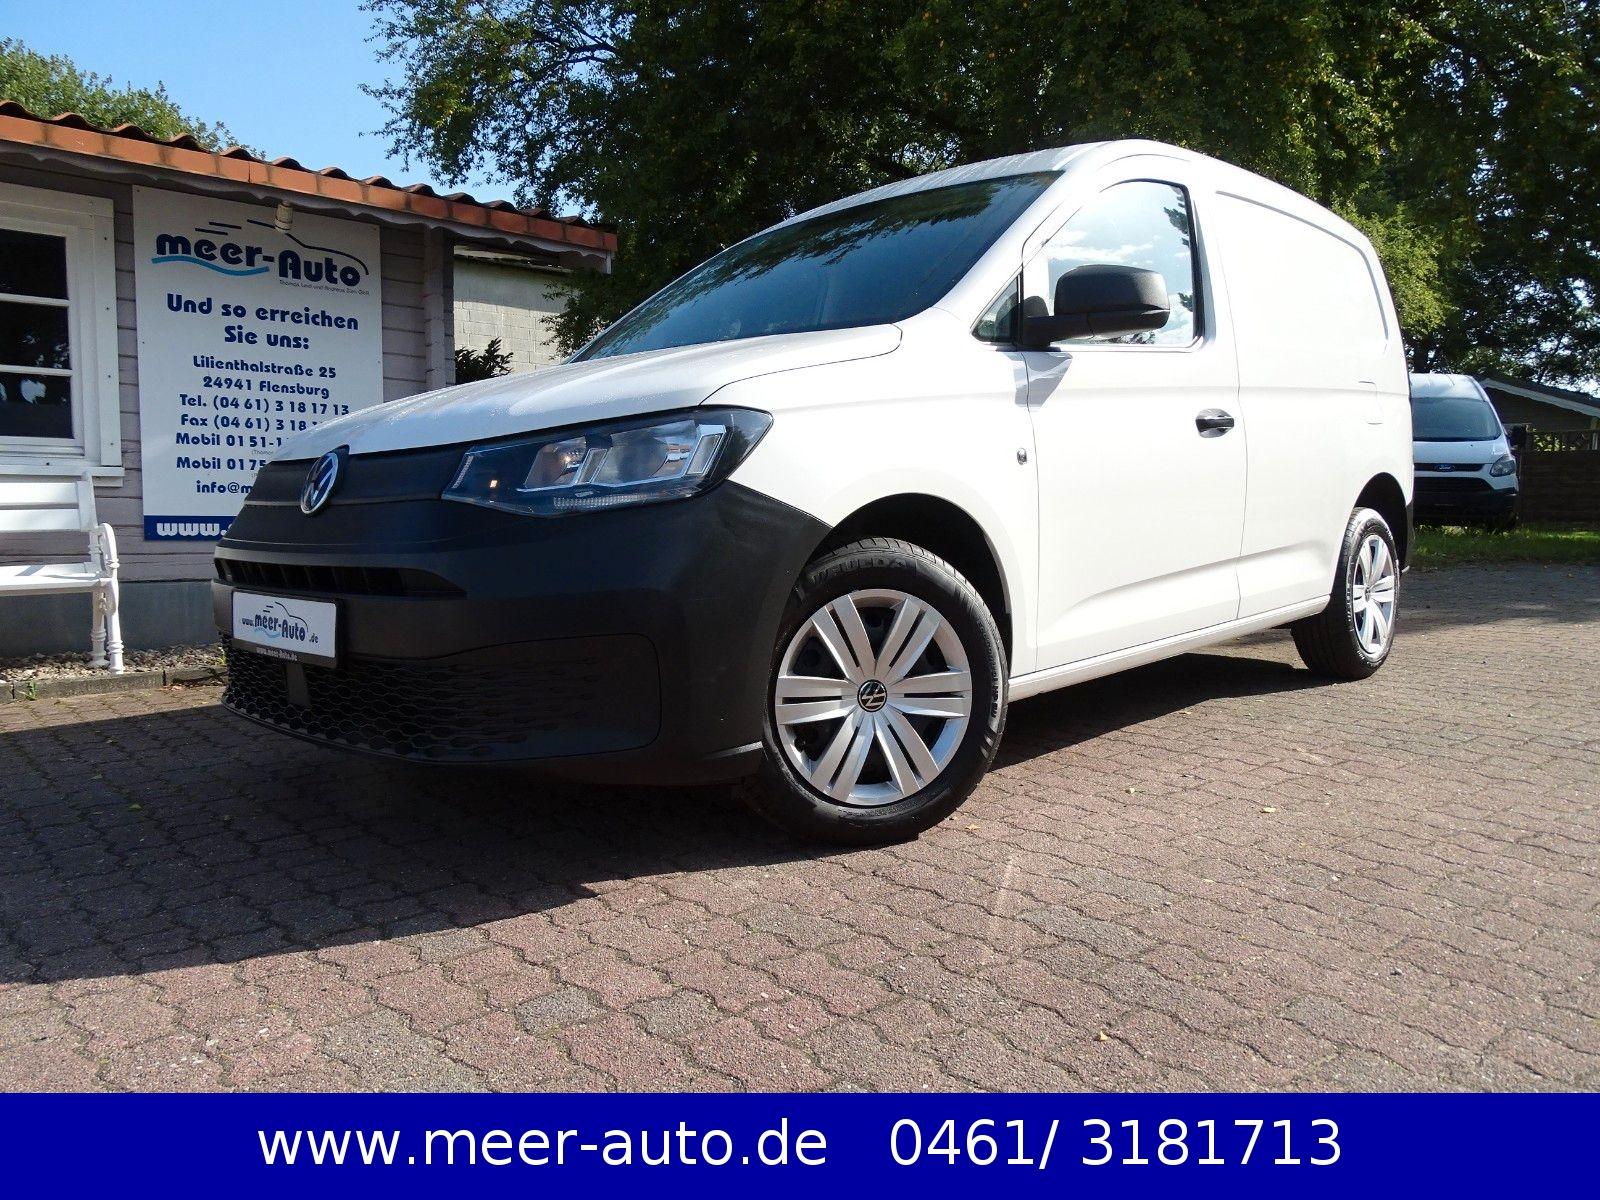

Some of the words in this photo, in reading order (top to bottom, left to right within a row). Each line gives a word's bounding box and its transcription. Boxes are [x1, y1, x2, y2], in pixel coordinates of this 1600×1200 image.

[155, 233, 361, 287] meer-Auto
[167, 293, 212, 315] Und
[221, 303, 247, 318] so
[255, 307, 359, 331] erreichen
[224, 325, 258, 345] Sie
[266, 332, 310, 350] uns:
[193, 355, 314, 377] Lilienthalstraße
[319, 366, 337, 379] 25
[203, 376, 252, 391] 24941
[259, 380, 330, 399] Flensburg
[180, 393, 207, 407] Tel.
[181, 414, 208, 427] Fax
[176, 432, 221, 447] Mobil
[176, 456, 221, 471] Mobil
